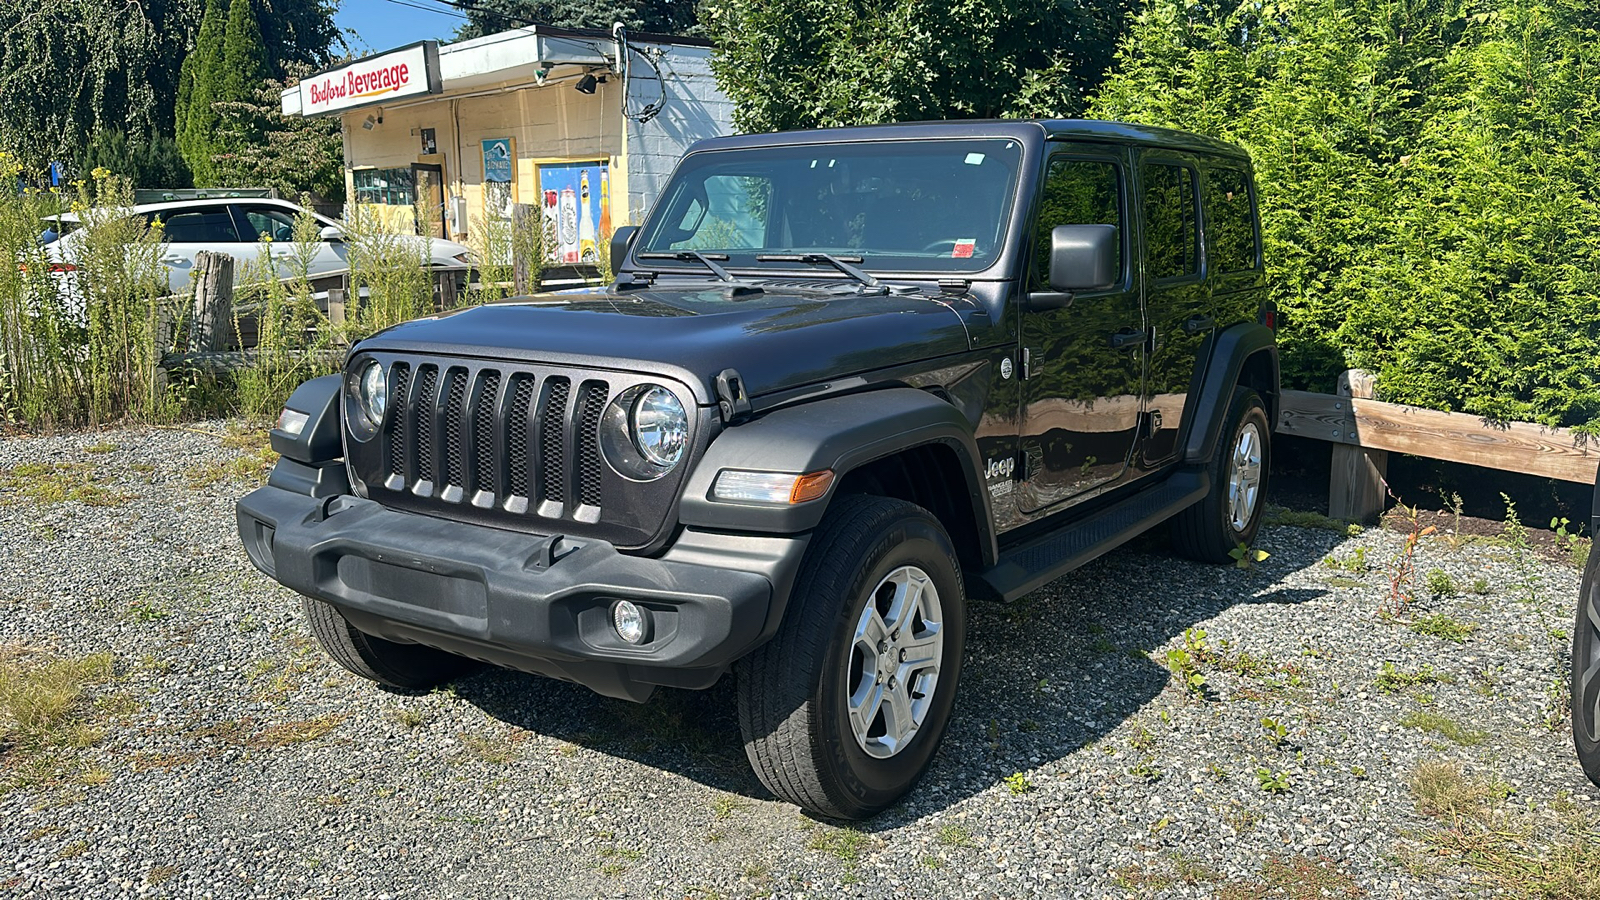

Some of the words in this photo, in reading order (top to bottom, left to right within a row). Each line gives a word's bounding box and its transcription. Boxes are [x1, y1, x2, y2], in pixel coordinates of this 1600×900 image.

[310, 76, 346, 105] Bedford
[347, 63, 409, 92] Beverage
[984, 456, 1015, 480] Jeep
